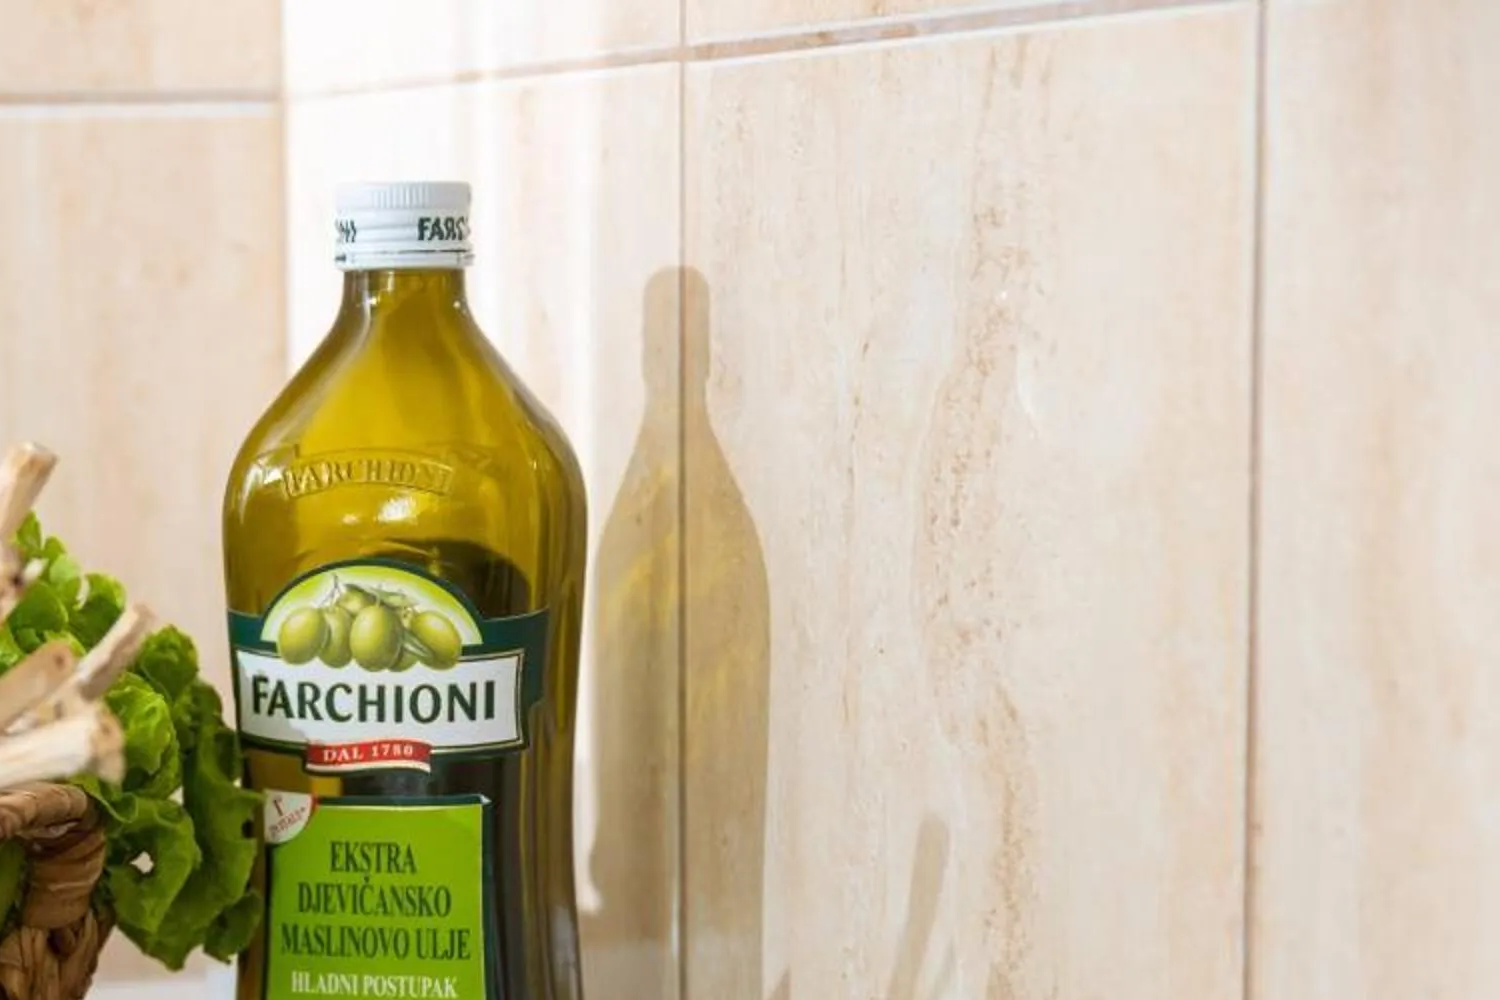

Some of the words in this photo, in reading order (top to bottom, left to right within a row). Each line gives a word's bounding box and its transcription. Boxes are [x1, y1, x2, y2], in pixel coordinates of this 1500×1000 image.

[252, 673, 496, 723] FARCHIONI
[322, 746, 364, 763] DAL
[371, 743, 415, 759] 1780
[329, 841, 417, 875] EKSTRA
[297, 876, 452, 918] DJEVIČANSKO
[280, 922, 411, 960] MASLINOVO
[415, 927, 472, 960] ULJE
[290, 970, 358, 998] HLADNI
[362, 973, 458, 1000] POSTUPAK
